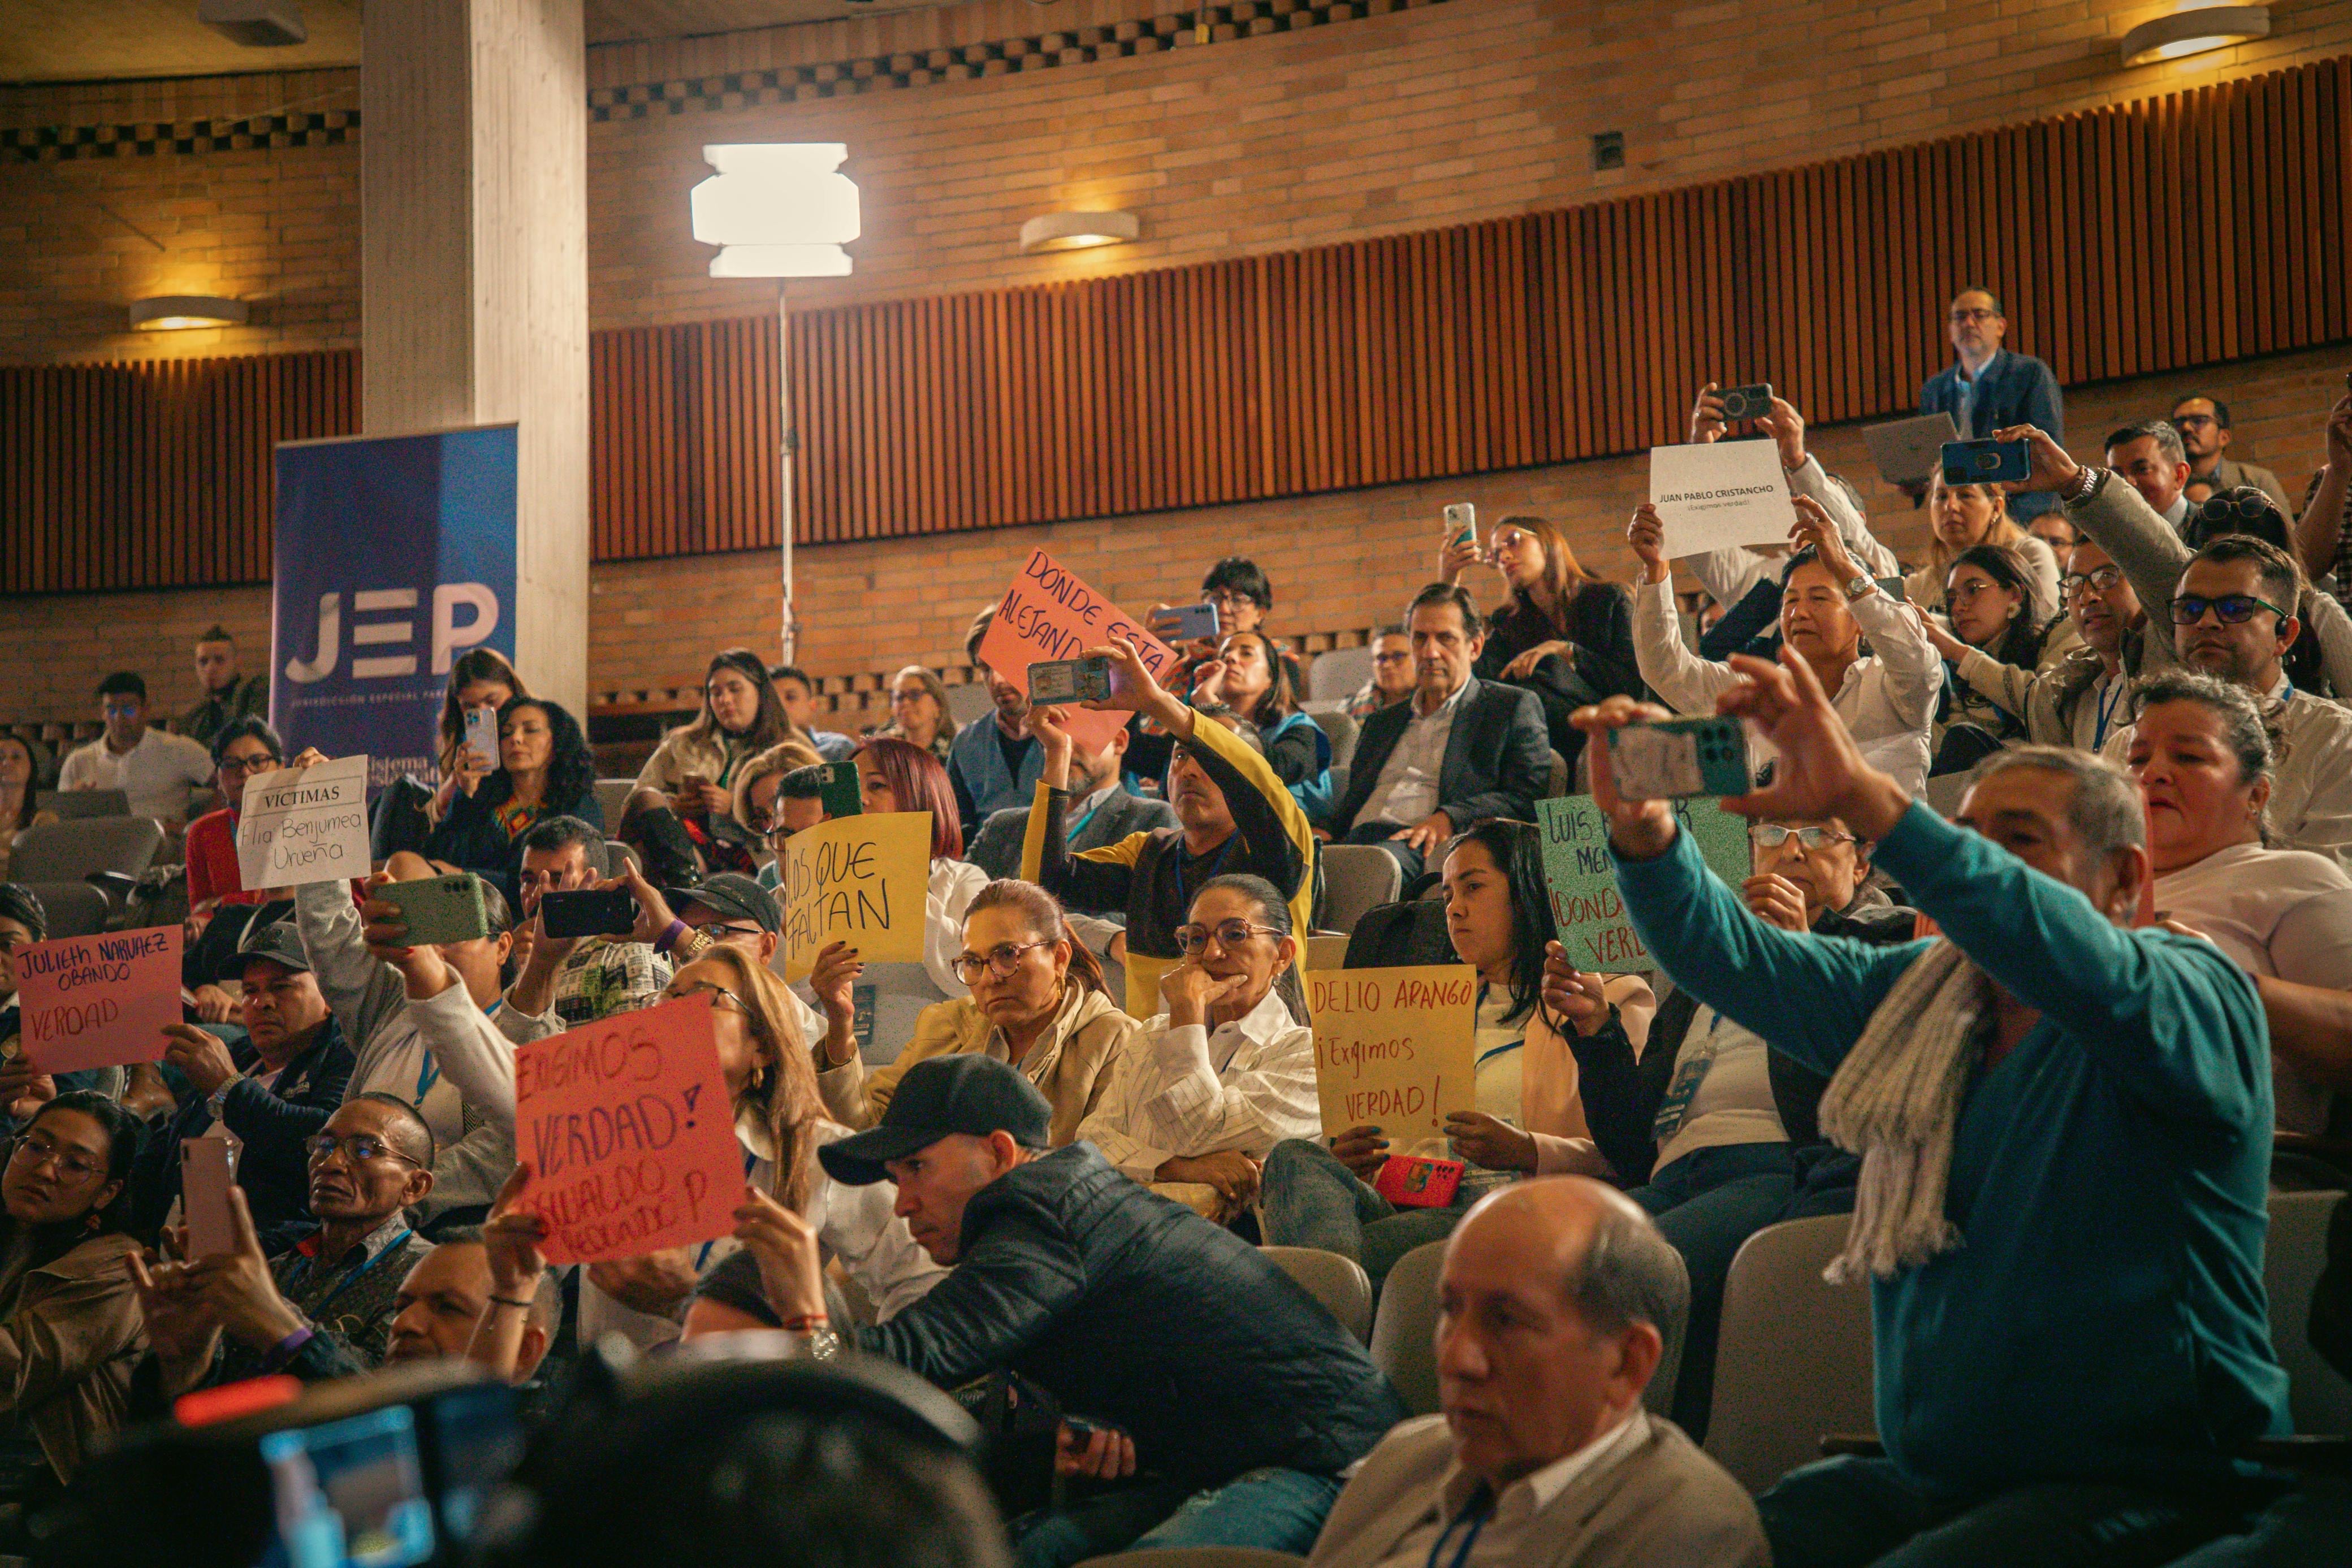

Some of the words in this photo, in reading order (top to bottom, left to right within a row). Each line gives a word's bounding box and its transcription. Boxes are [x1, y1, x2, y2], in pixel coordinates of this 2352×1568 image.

[1659, 493, 1682, 503] JUAN
[1684, 491, 1713, 501] PABLO
[1715, 484, 1774, 498] CRISTANCHO
[285, 582, 499, 683] JEP
[998, 589, 1083, 660] ALEJAND
[282, 813, 361, 844] Benjumea
[816, 841, 877, 897] QUE
[788, 878, 889, 960] FALTAN
[1548, 877, 1625, 927] ¡DOND
[58, 963, 130, 991] OBANDO
[1314, 981, 1380, 1013] DELIO
[1394, 980, 1472, 1010] ARANGO
